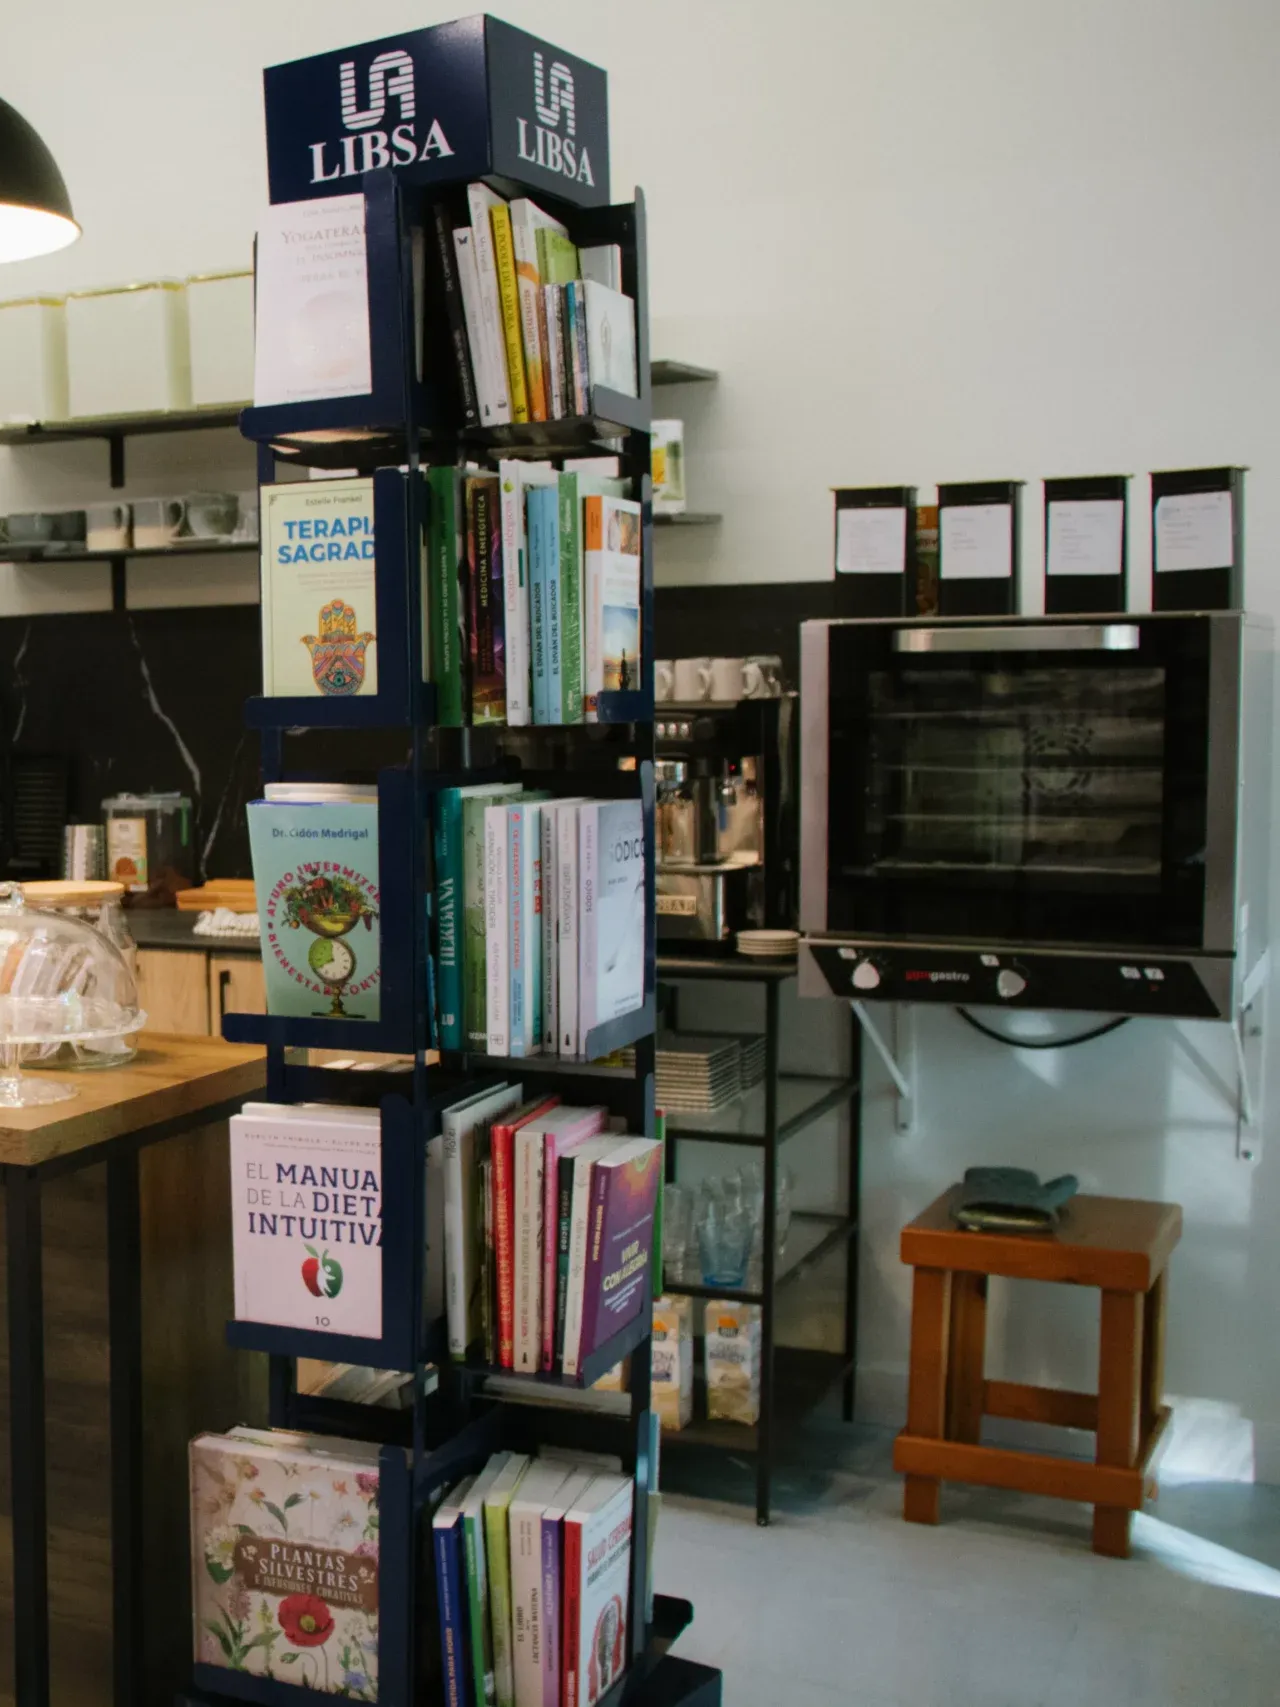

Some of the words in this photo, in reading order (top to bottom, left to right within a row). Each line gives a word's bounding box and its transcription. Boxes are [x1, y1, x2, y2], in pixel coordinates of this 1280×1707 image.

[309, 117, 455, 184] LIBSA
[516, 116, 595, 188] LIBSA
[281, 223, 366, 245] YOGATERA
[496, 220, 505, 231] EL
[498, 235, 509, 268] PODER
[504, 294, 514, 330] AHORA
[476, 494, 487, 555] ENERGÉTICA
[479, 559, 489, 607] MEDICINA
[534, 582, 542, 623] BUSCADOR
[549, 579, 557, 620] BUSCADOR
[535, 626, 543, 640] DEL
[550, 622, 558, 637] DEL
[535, 642, 543, 666] DIVÁN
[550, 639, 558, 664] DIVÁN
[272, 828, 288, 838] Dr.
[289, 827, 319, 839] Cidón
[321, 828, 368, 841] Madrigal
[246, 1162, 269, 1181] EL
[275, 1162, 380, 1192] MANUA
[247, 1187, 272, 1206] DE
[280, 1190, 307, 1209] LA
[560, 1222, 568, 1250] LÚCIDO
[271, 1543, 346, 1572] PLANTAS
[259, 1557, 359, 1592] SILVESTRES
[516, 1606, 524, 1630] LIBRO
[517, 1633, 525, 1642] EL
